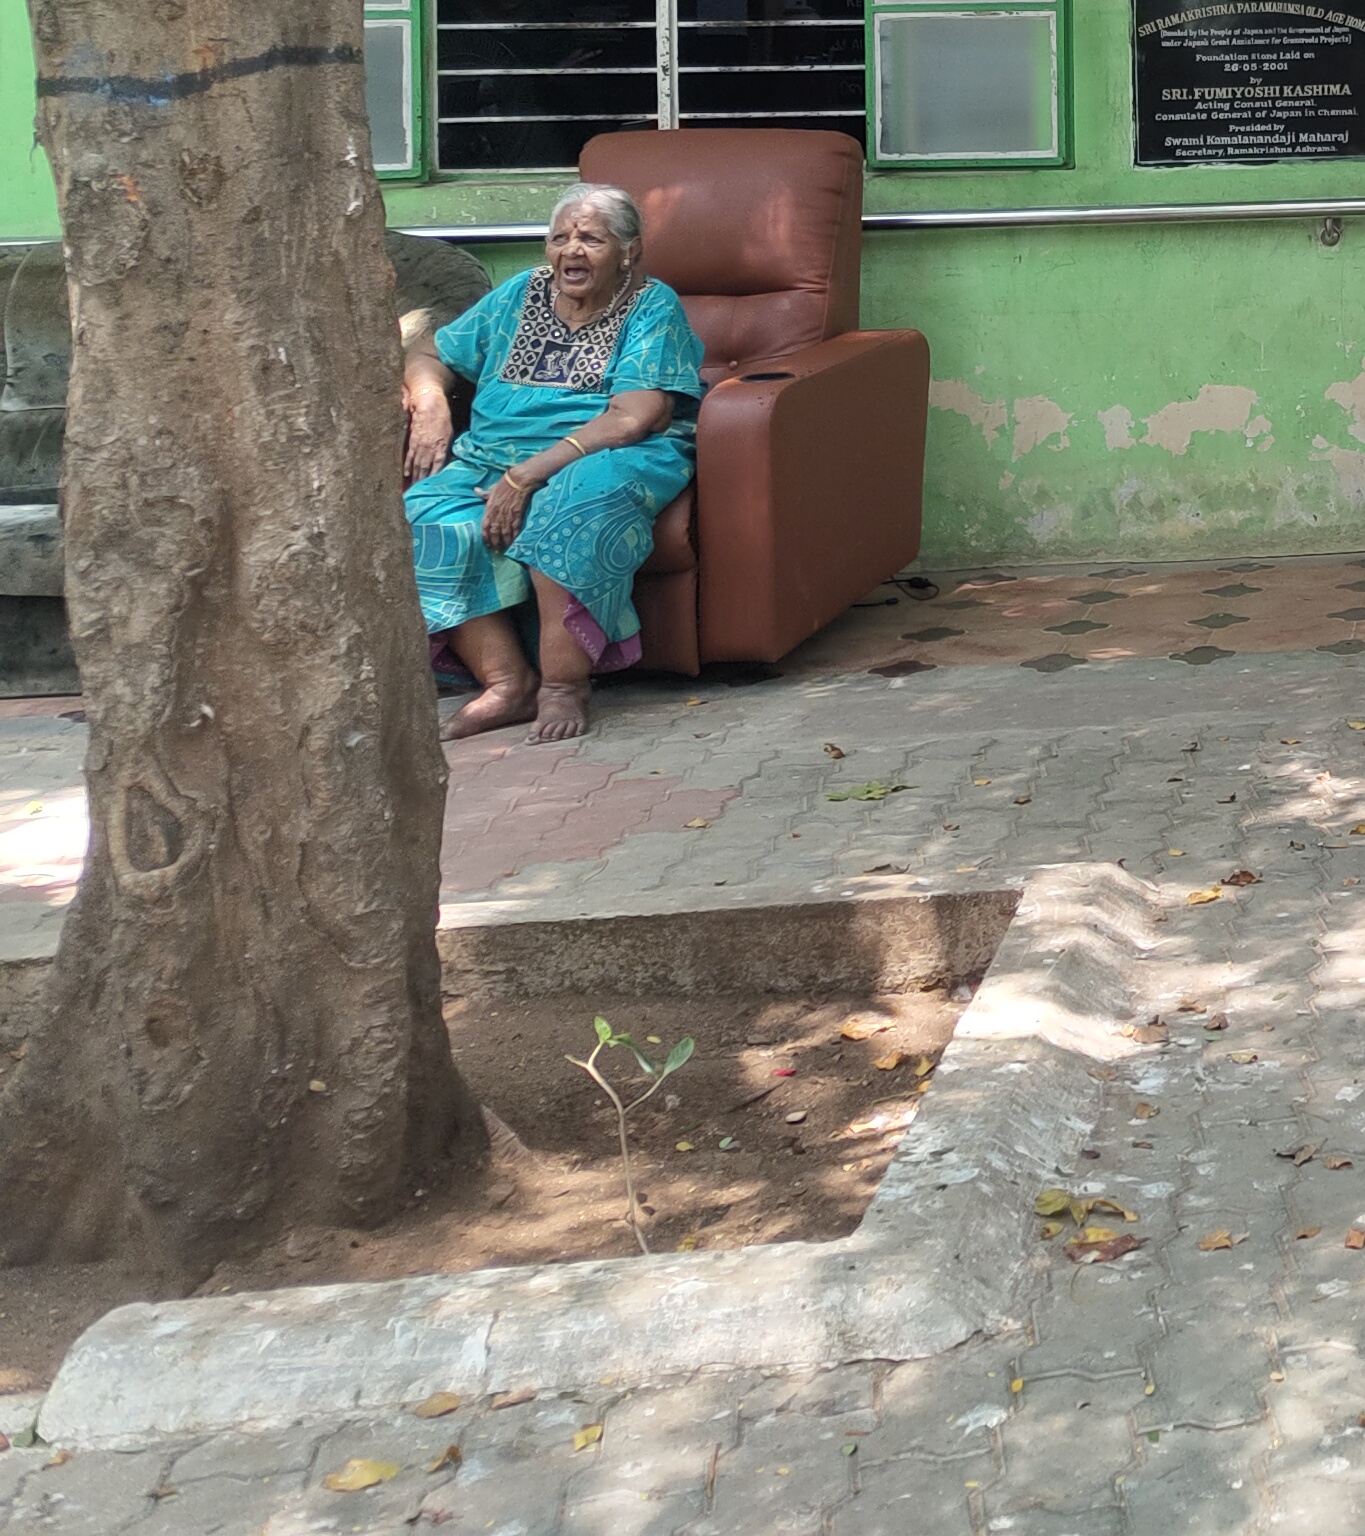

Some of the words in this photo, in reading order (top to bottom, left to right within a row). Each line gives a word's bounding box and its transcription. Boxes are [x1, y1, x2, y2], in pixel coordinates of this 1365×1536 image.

[1138, 20, 1158, 38] SRI
[1155, 3, 1236, 31] RAMAKRISHNA
[1236, 2, 1305, 16] PARAMAHAMSA
[1305, 5, 1325, 19] OLD
[1323, 10, 1346, 25] AGE
[1210, 28, 1232, 38] People
[1233, 28, 1242, 36] of
[1242, 27, 1264, 37] Japan
[1210, 37, 1230, 47] Grant
[1195, 52, 1249, 62] Foundation
[1279, 50, 1301, 61] Laid
[1303, 52, 1316, 60] on
[1249, 76, 1263, 86] by
[1282, 84, 1352, 98] KASHIMA
[1194, 100, 1231, 111] Acting
[1233, 100, 1273, 110] Consul
[1155, 112, 1208, 121] Consulate
[1210, 110, 1252, 121] General
[1255, 110, 1268, 119] of
[1269, 110, 1302, 120] Japan
[1304, 108, 1316, 117] in
[1228, 124, 1272, 133] Presided
[1273, 123, 1285, 133] by
[1164, 134, 1205, 146] Swami
[1206, 131, 1296, 146] Kamalanandaji
[1298, 130, 1350, 145] Maharaj
[1175, 147, 1226, 158] Secretary,
[1226, 146, 1293, 156] Ramakrishna
